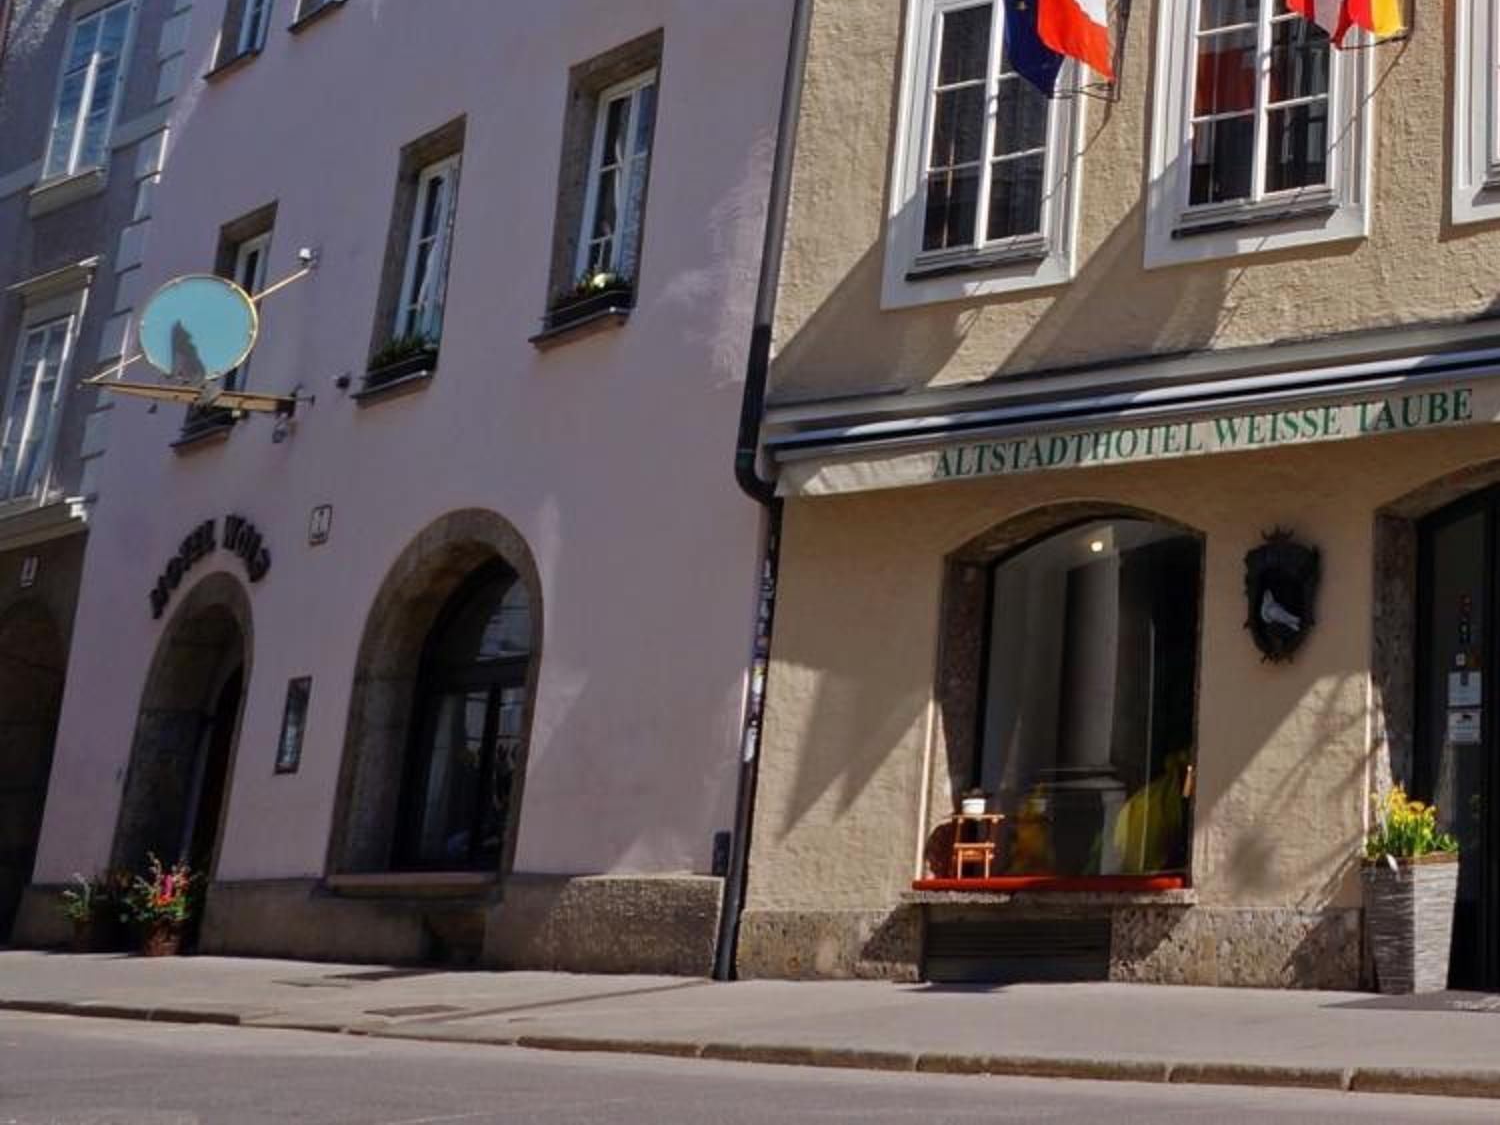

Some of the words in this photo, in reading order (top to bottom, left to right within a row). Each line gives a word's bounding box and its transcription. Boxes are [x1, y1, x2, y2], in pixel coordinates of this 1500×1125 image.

[932, 421, 1203, 476] ALTSTADTHOTEL
[1214, 404, 1342, 445] WEISSE
[1353, 388, 1473, 432] TAUBE
